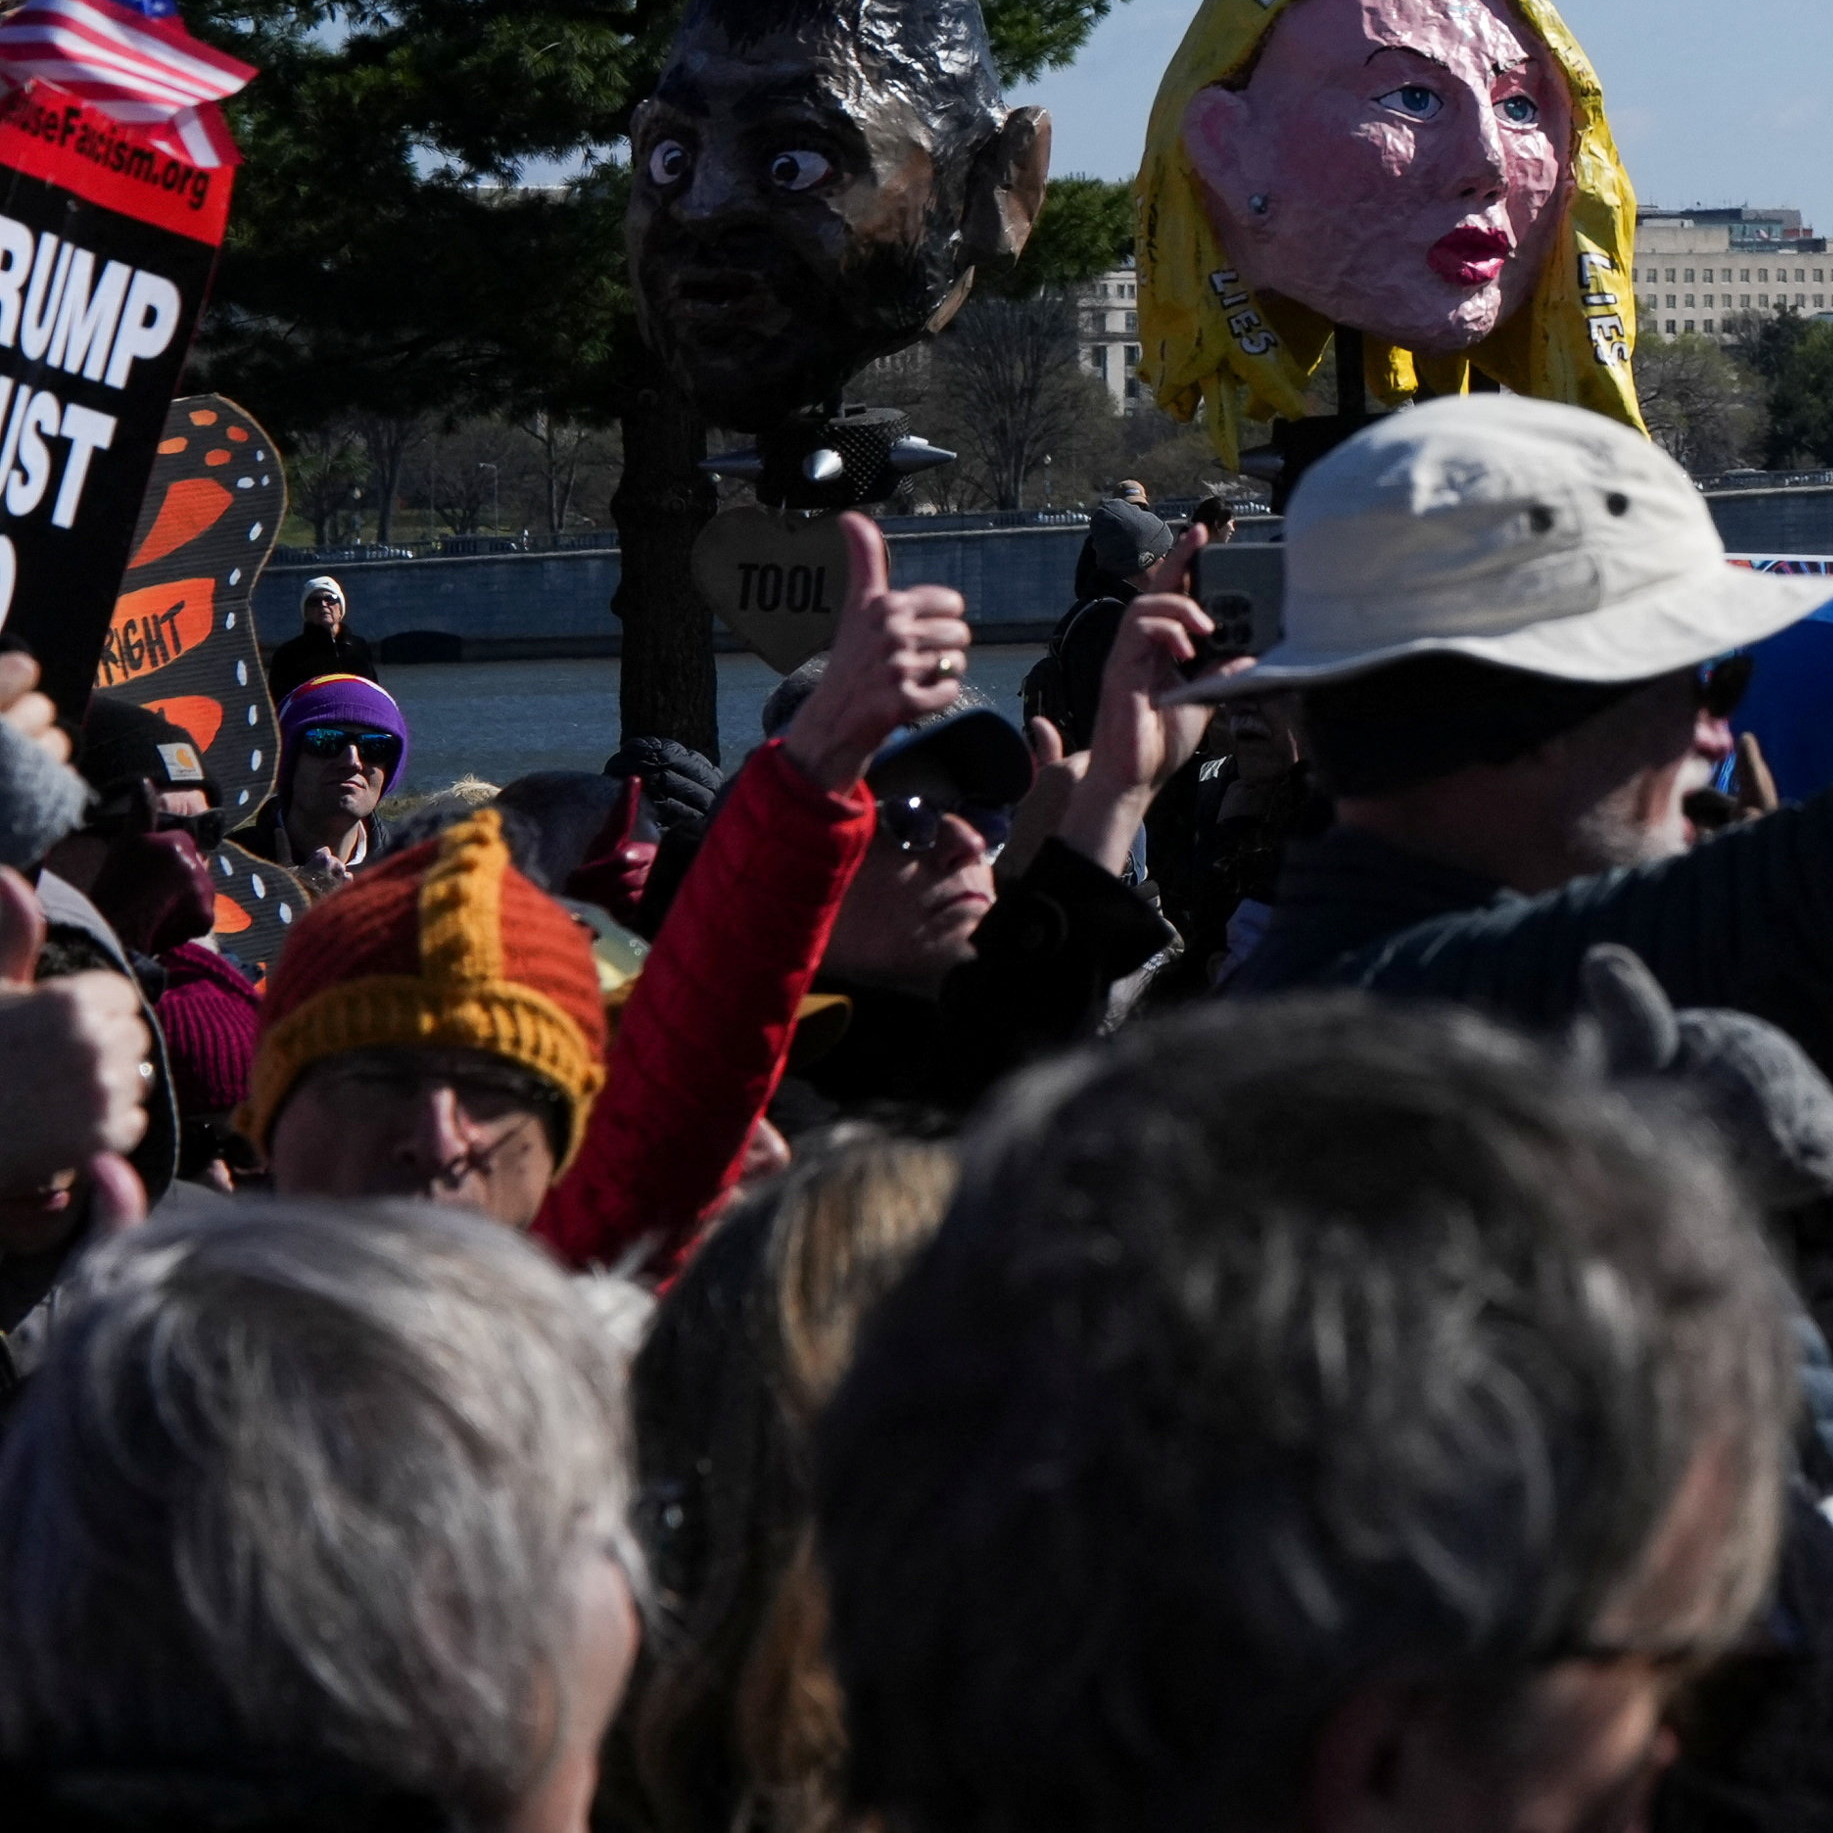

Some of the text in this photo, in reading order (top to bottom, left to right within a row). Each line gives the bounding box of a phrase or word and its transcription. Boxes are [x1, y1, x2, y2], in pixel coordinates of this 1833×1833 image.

[0, 214, 182, 390] RUMP
[1208, 268, 1279, 356] LIES
[1578, 252, 1630, 366] LIES
[0, 373, 118, 530] UST
[737, 562, 832, 614] TOOL
[94, 600, 186, 687] RIGHT
